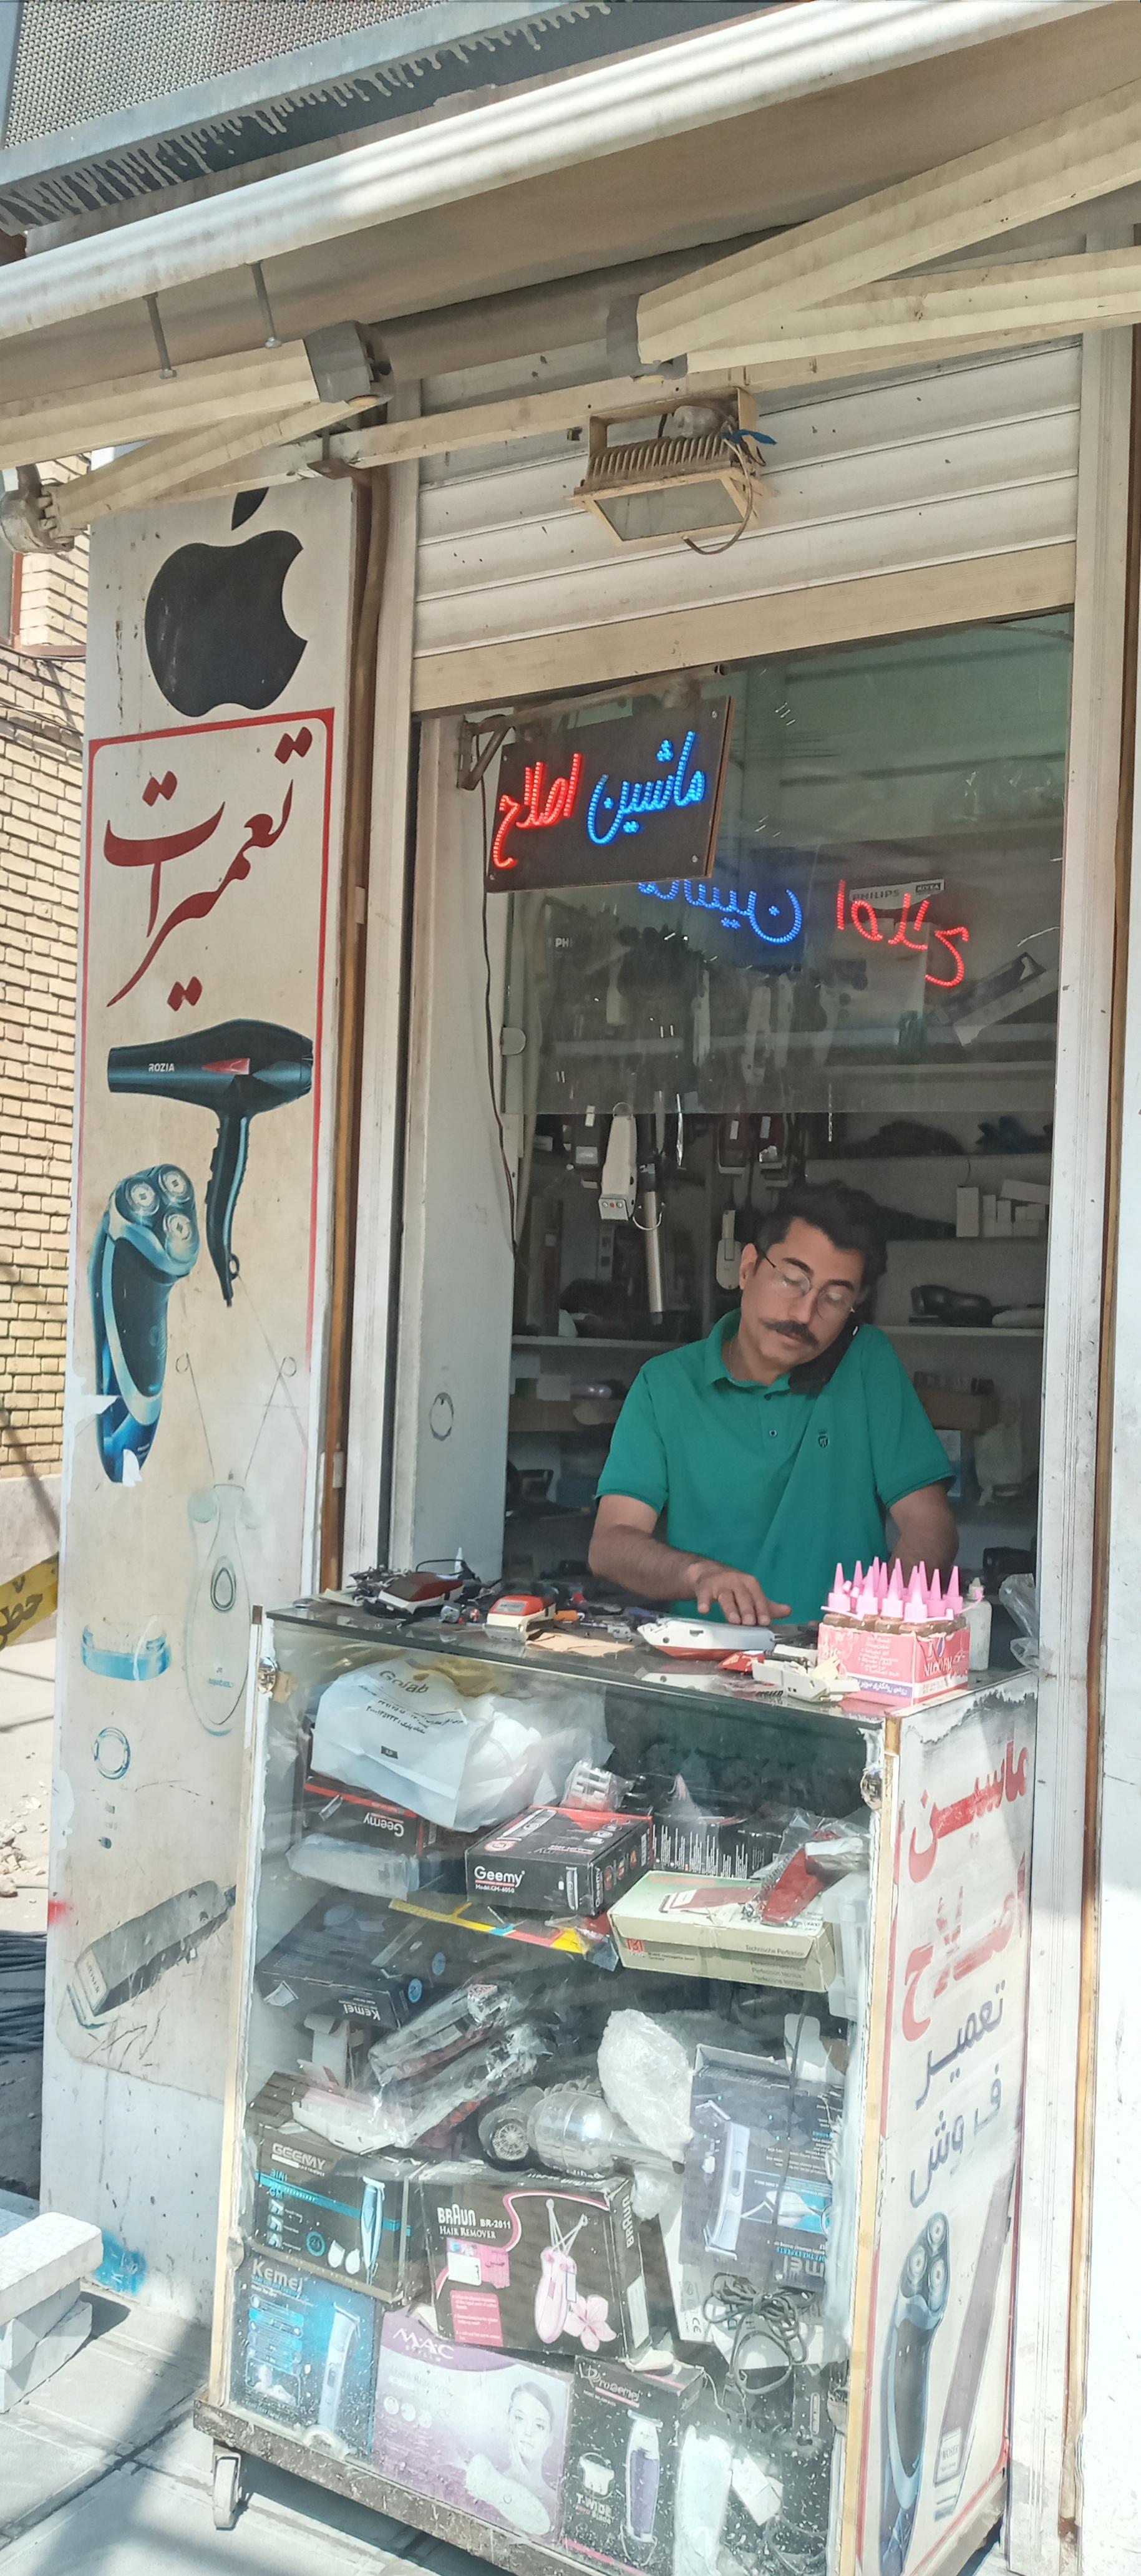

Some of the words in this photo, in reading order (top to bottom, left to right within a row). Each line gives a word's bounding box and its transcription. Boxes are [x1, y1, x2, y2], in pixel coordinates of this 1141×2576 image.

[586, 730, 705, 845] ماشین
[492, 752, 585, 868] اصلاح
[104, 726, 313, 1012] تعمیرات
[852, 889, 900, 900] PHILIPS
[148, 1062, 175, 1073] ROZIA
[379, 1670, 430, 1693] Golab
[363, 1812, 405, 1837] Geemy
[474, 1865, 523, 1887] Geemy
[915, 1980, 1006, 2111] تعمیر
[273, 2142, 326, 2170] GEEMY
[480, 2218, 511, 2230] BR-2011
